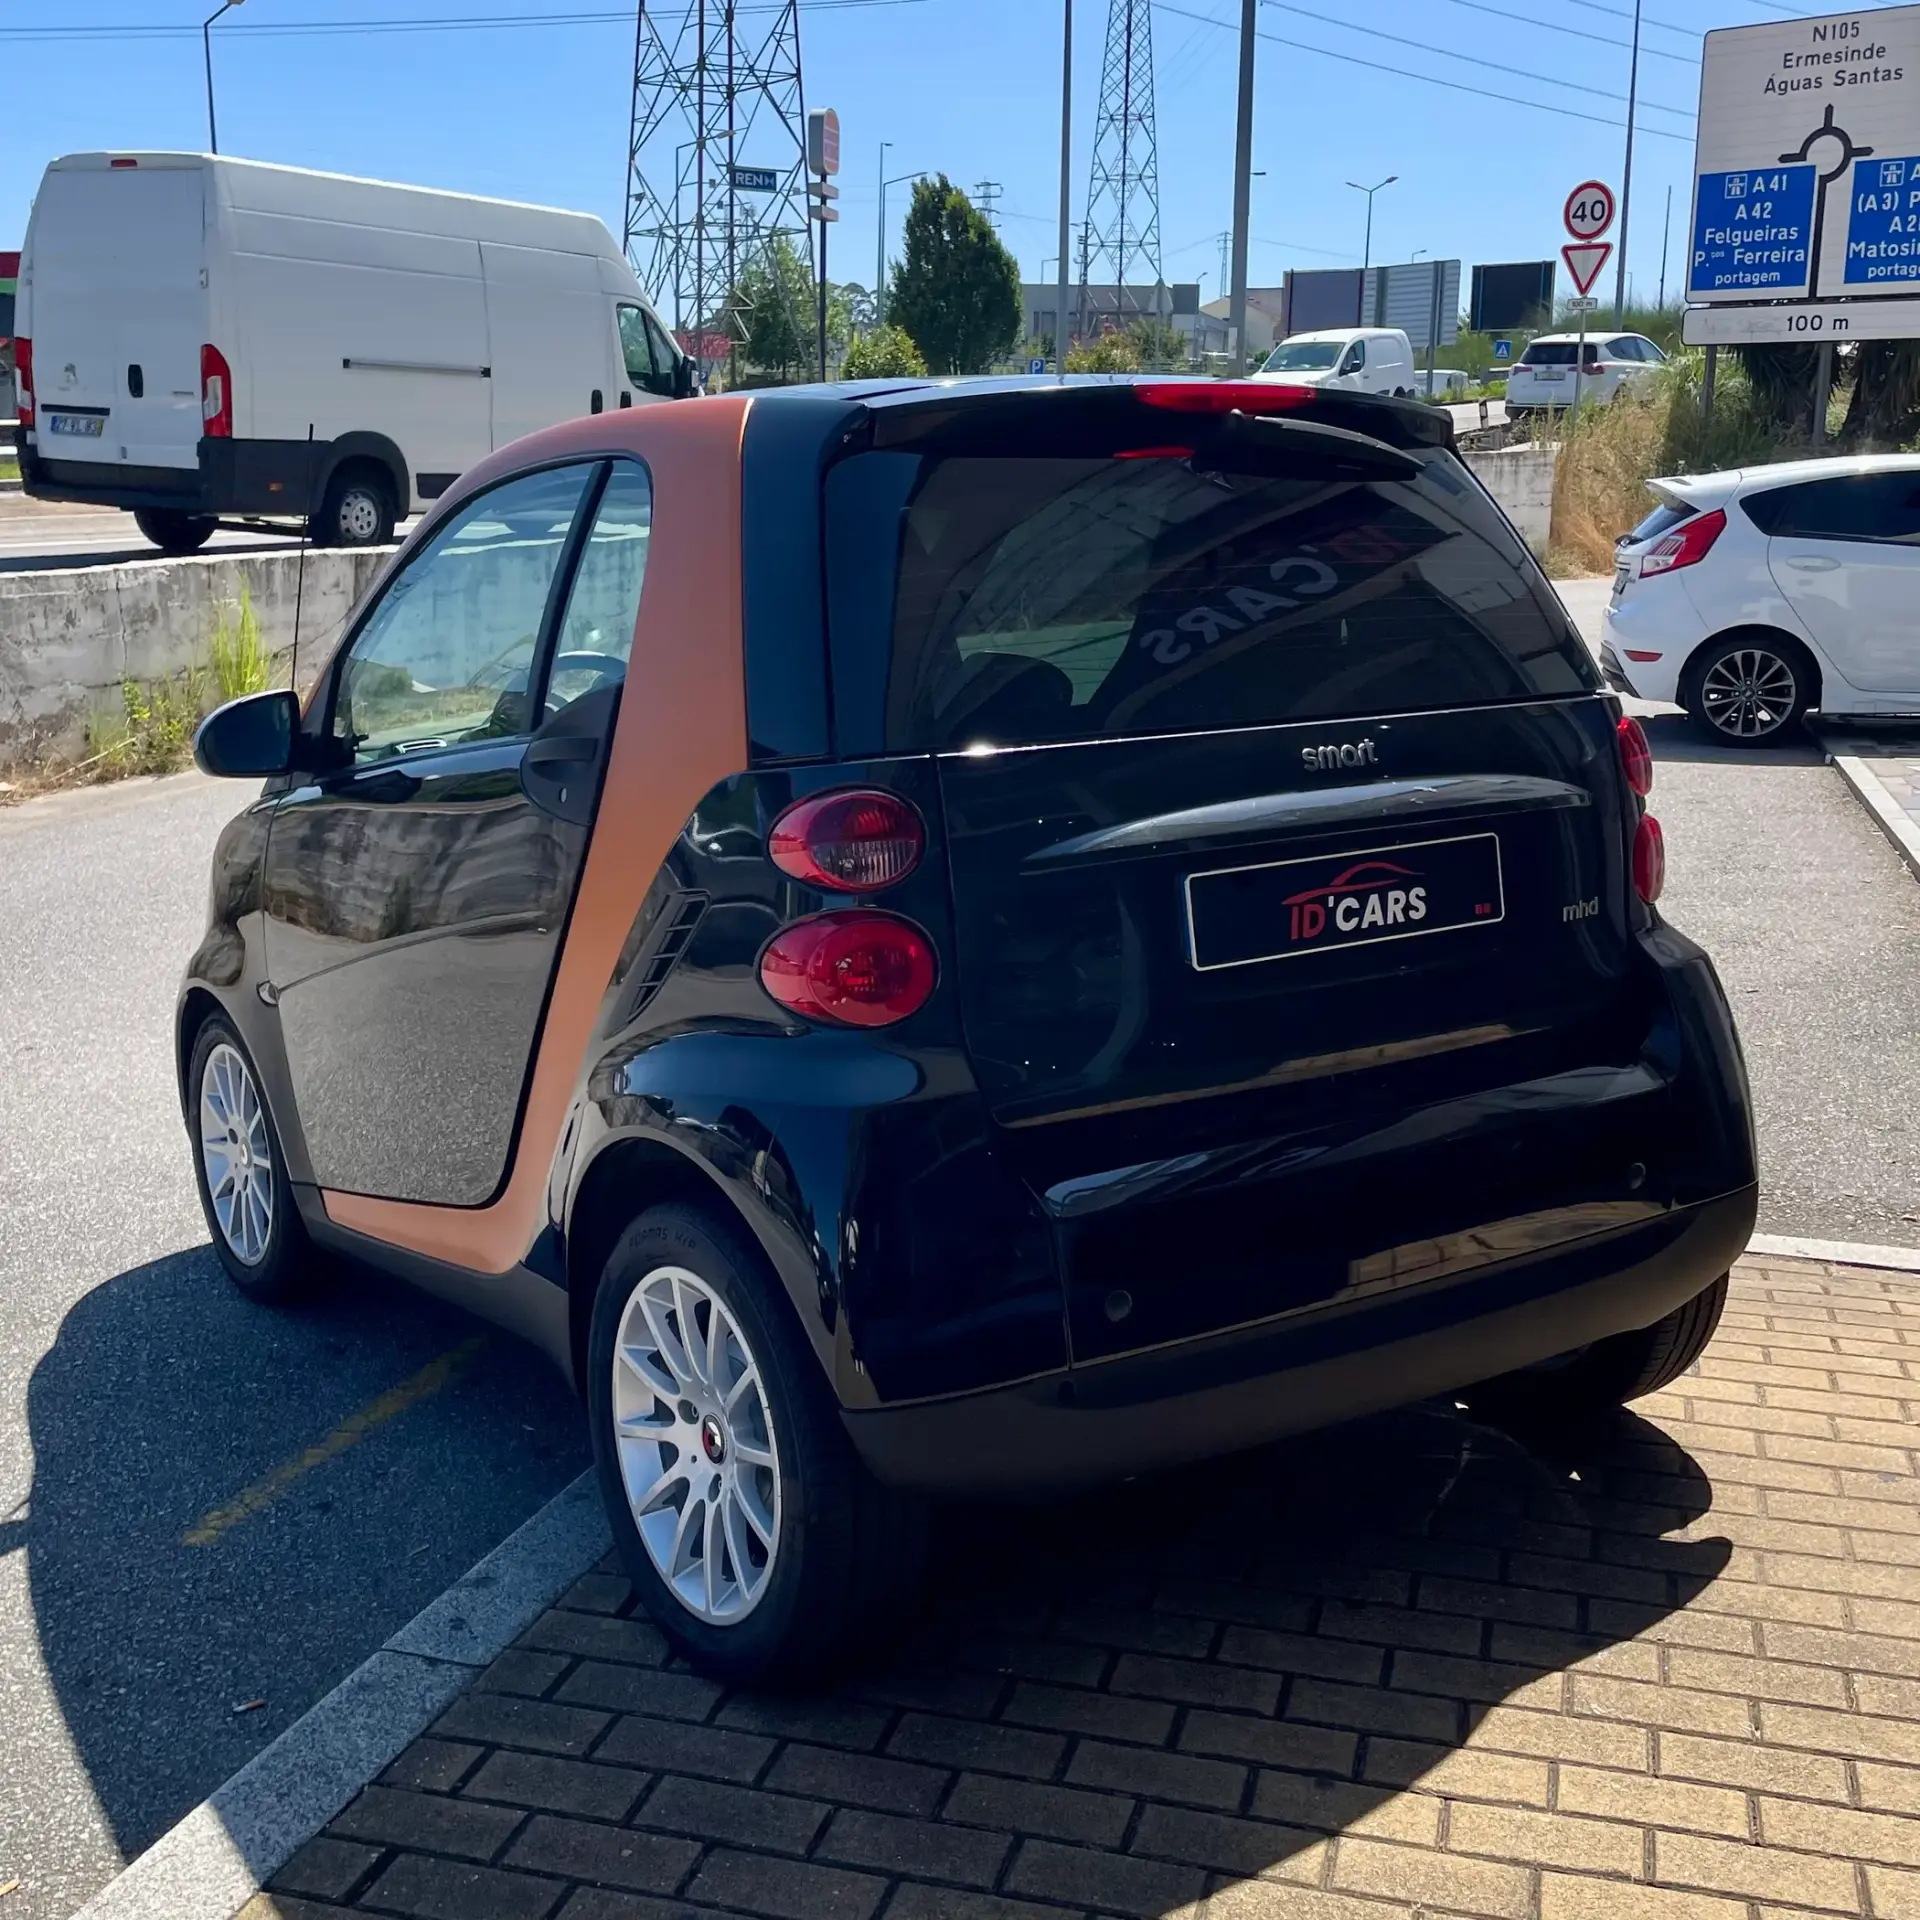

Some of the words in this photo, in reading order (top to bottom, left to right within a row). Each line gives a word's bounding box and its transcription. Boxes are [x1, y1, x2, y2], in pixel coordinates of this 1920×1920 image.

[1783, 42, 1887, 69] Ermesinde
[1763, 73, 1823, 96] Águas
[1833, 66, 1904, 87] Santas
[735, 172, 764, 187] REN
[1571, 199, 1606, 222] 40
[1906, 214, 1920, 233] 2
[1704, 224, 1799, 247] Felgueiras
[1733, 246, 1805, 266] Ferreira
[1848, 238, 1920, 260] Matosi
[1714, 271, 1781, 288] portagem
[1867, 263, 1920, 280] portag
[1786, 314, 1823, 332] 100
[1832, 318, 1849, 330] m
[1301, 738, 1379, 772] smart
[1562, 896, 1599, 922] mhd
